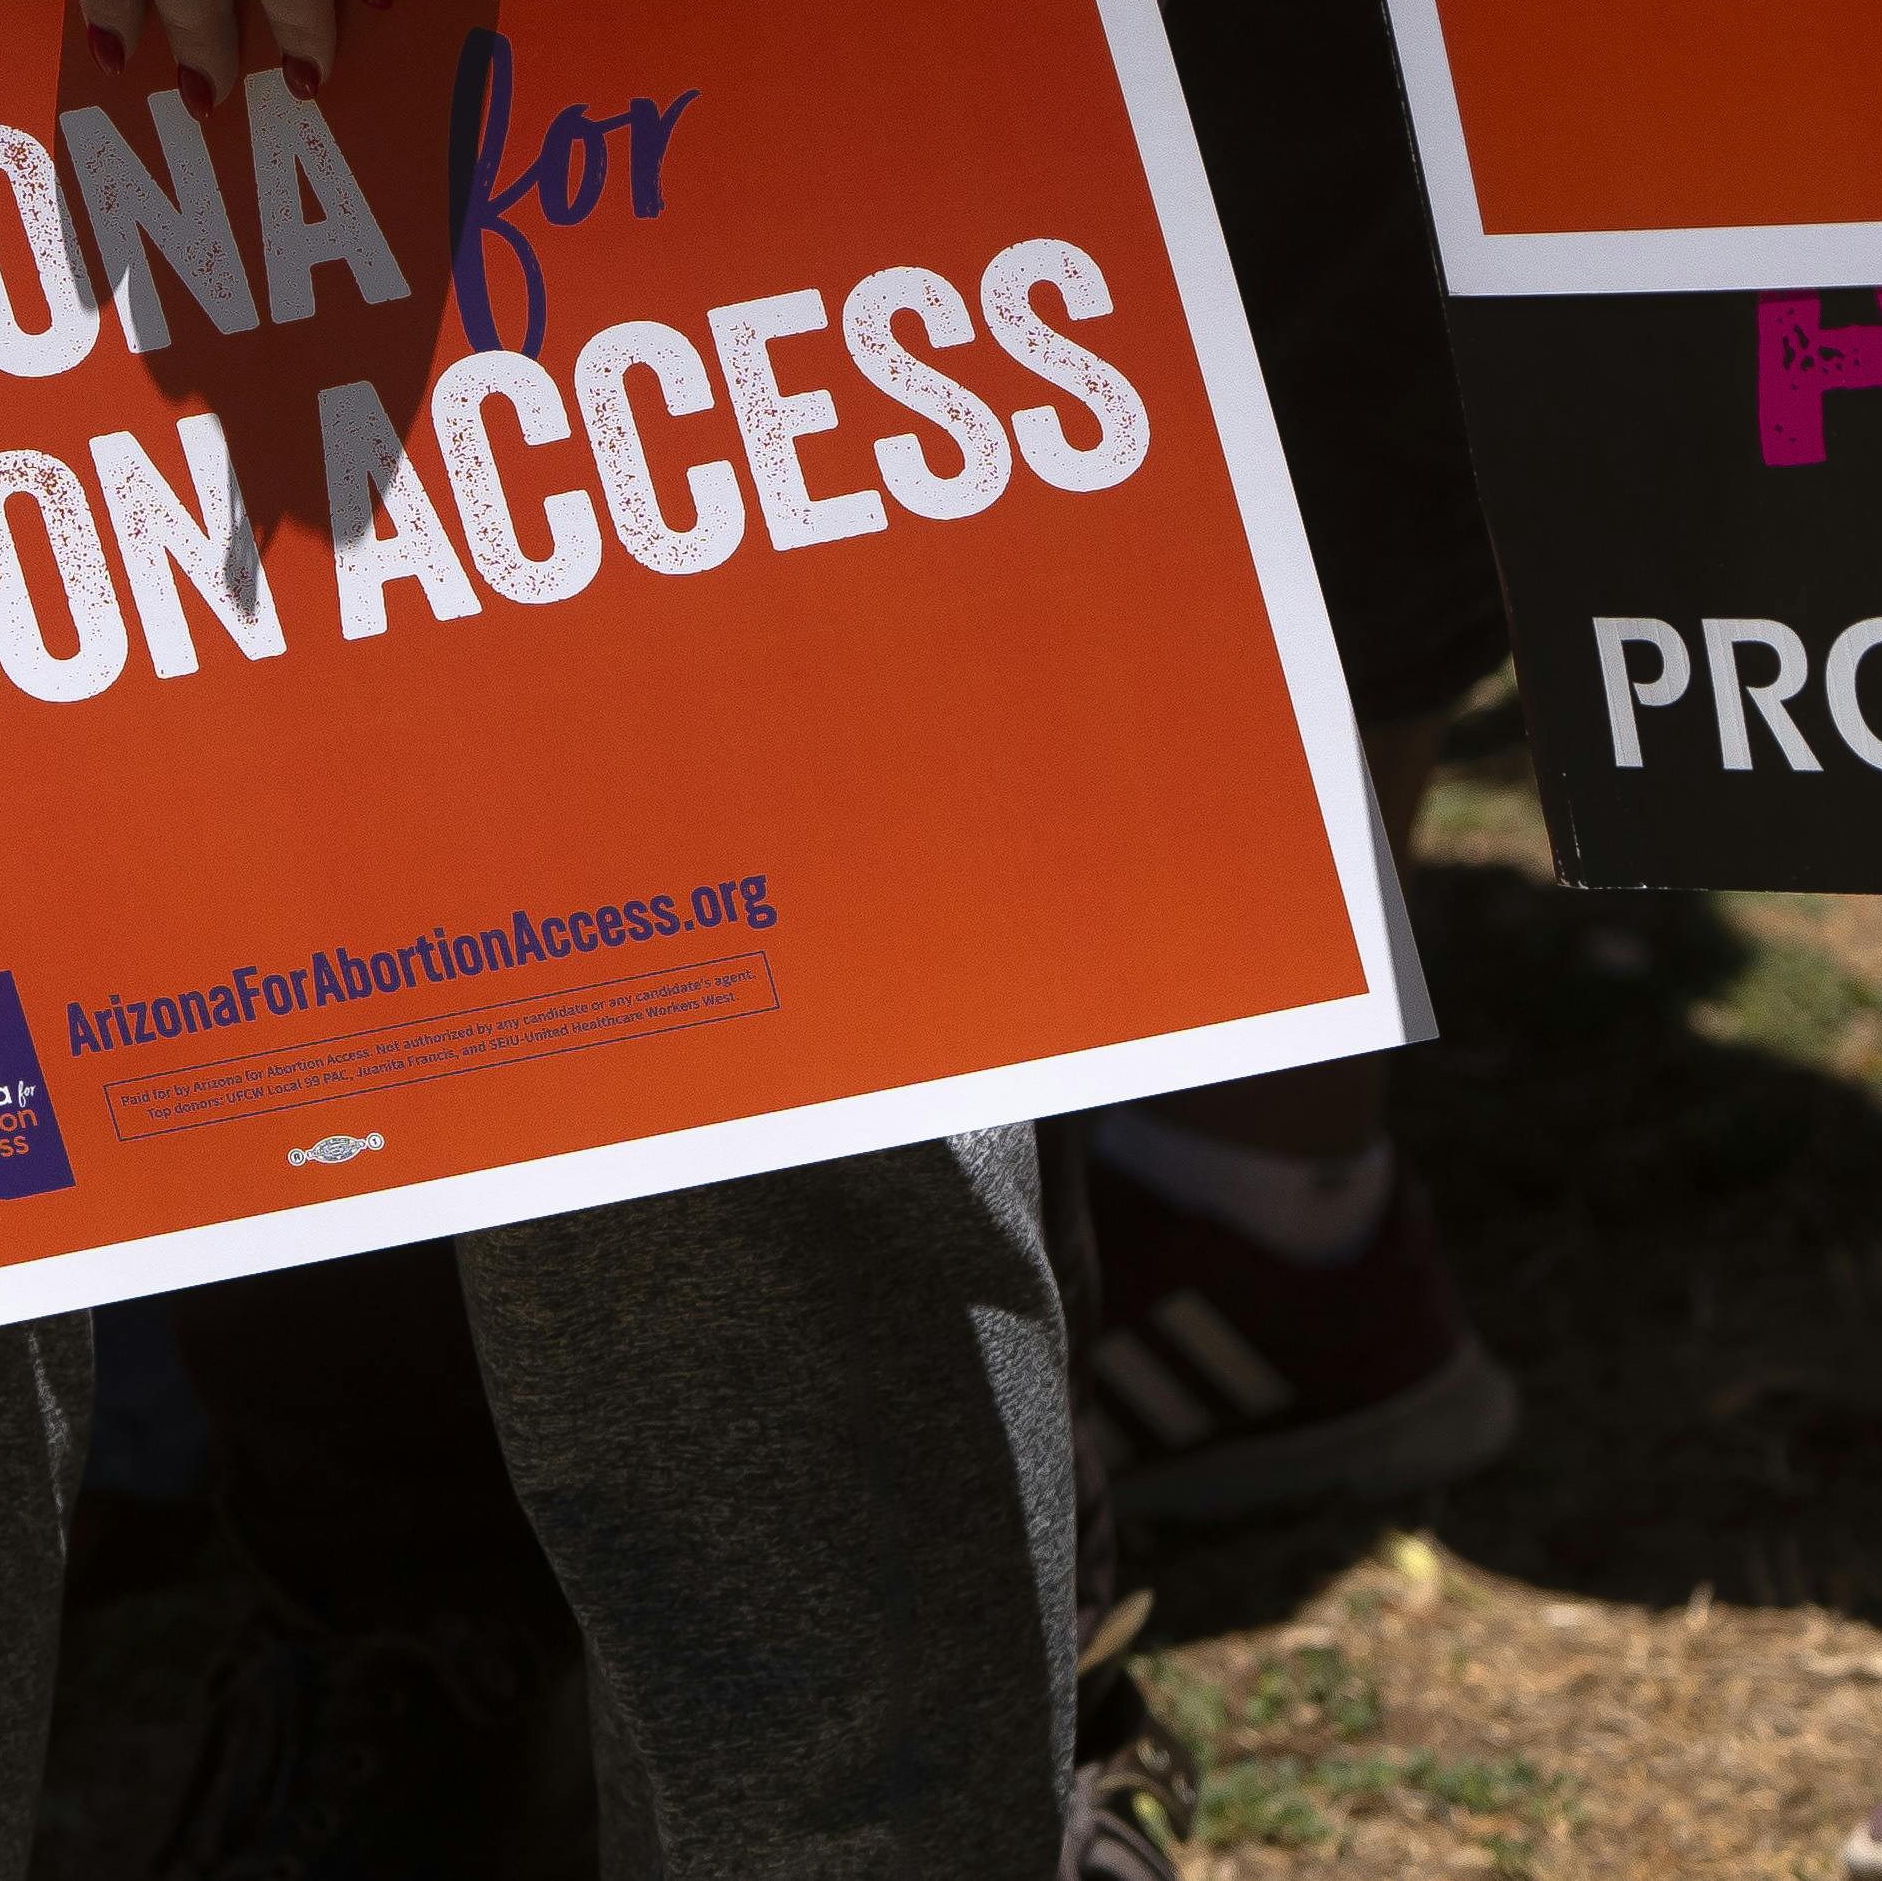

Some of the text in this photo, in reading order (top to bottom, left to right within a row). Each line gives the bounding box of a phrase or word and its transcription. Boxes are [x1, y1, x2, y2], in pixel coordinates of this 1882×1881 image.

[448, 26, 701, 359] for
[318, 239, 1150, 640] ACCESS
[18, 1081, 36, 1108] for
[67, 874, 779, 1058] ArizonaForAbortionAccess.org
